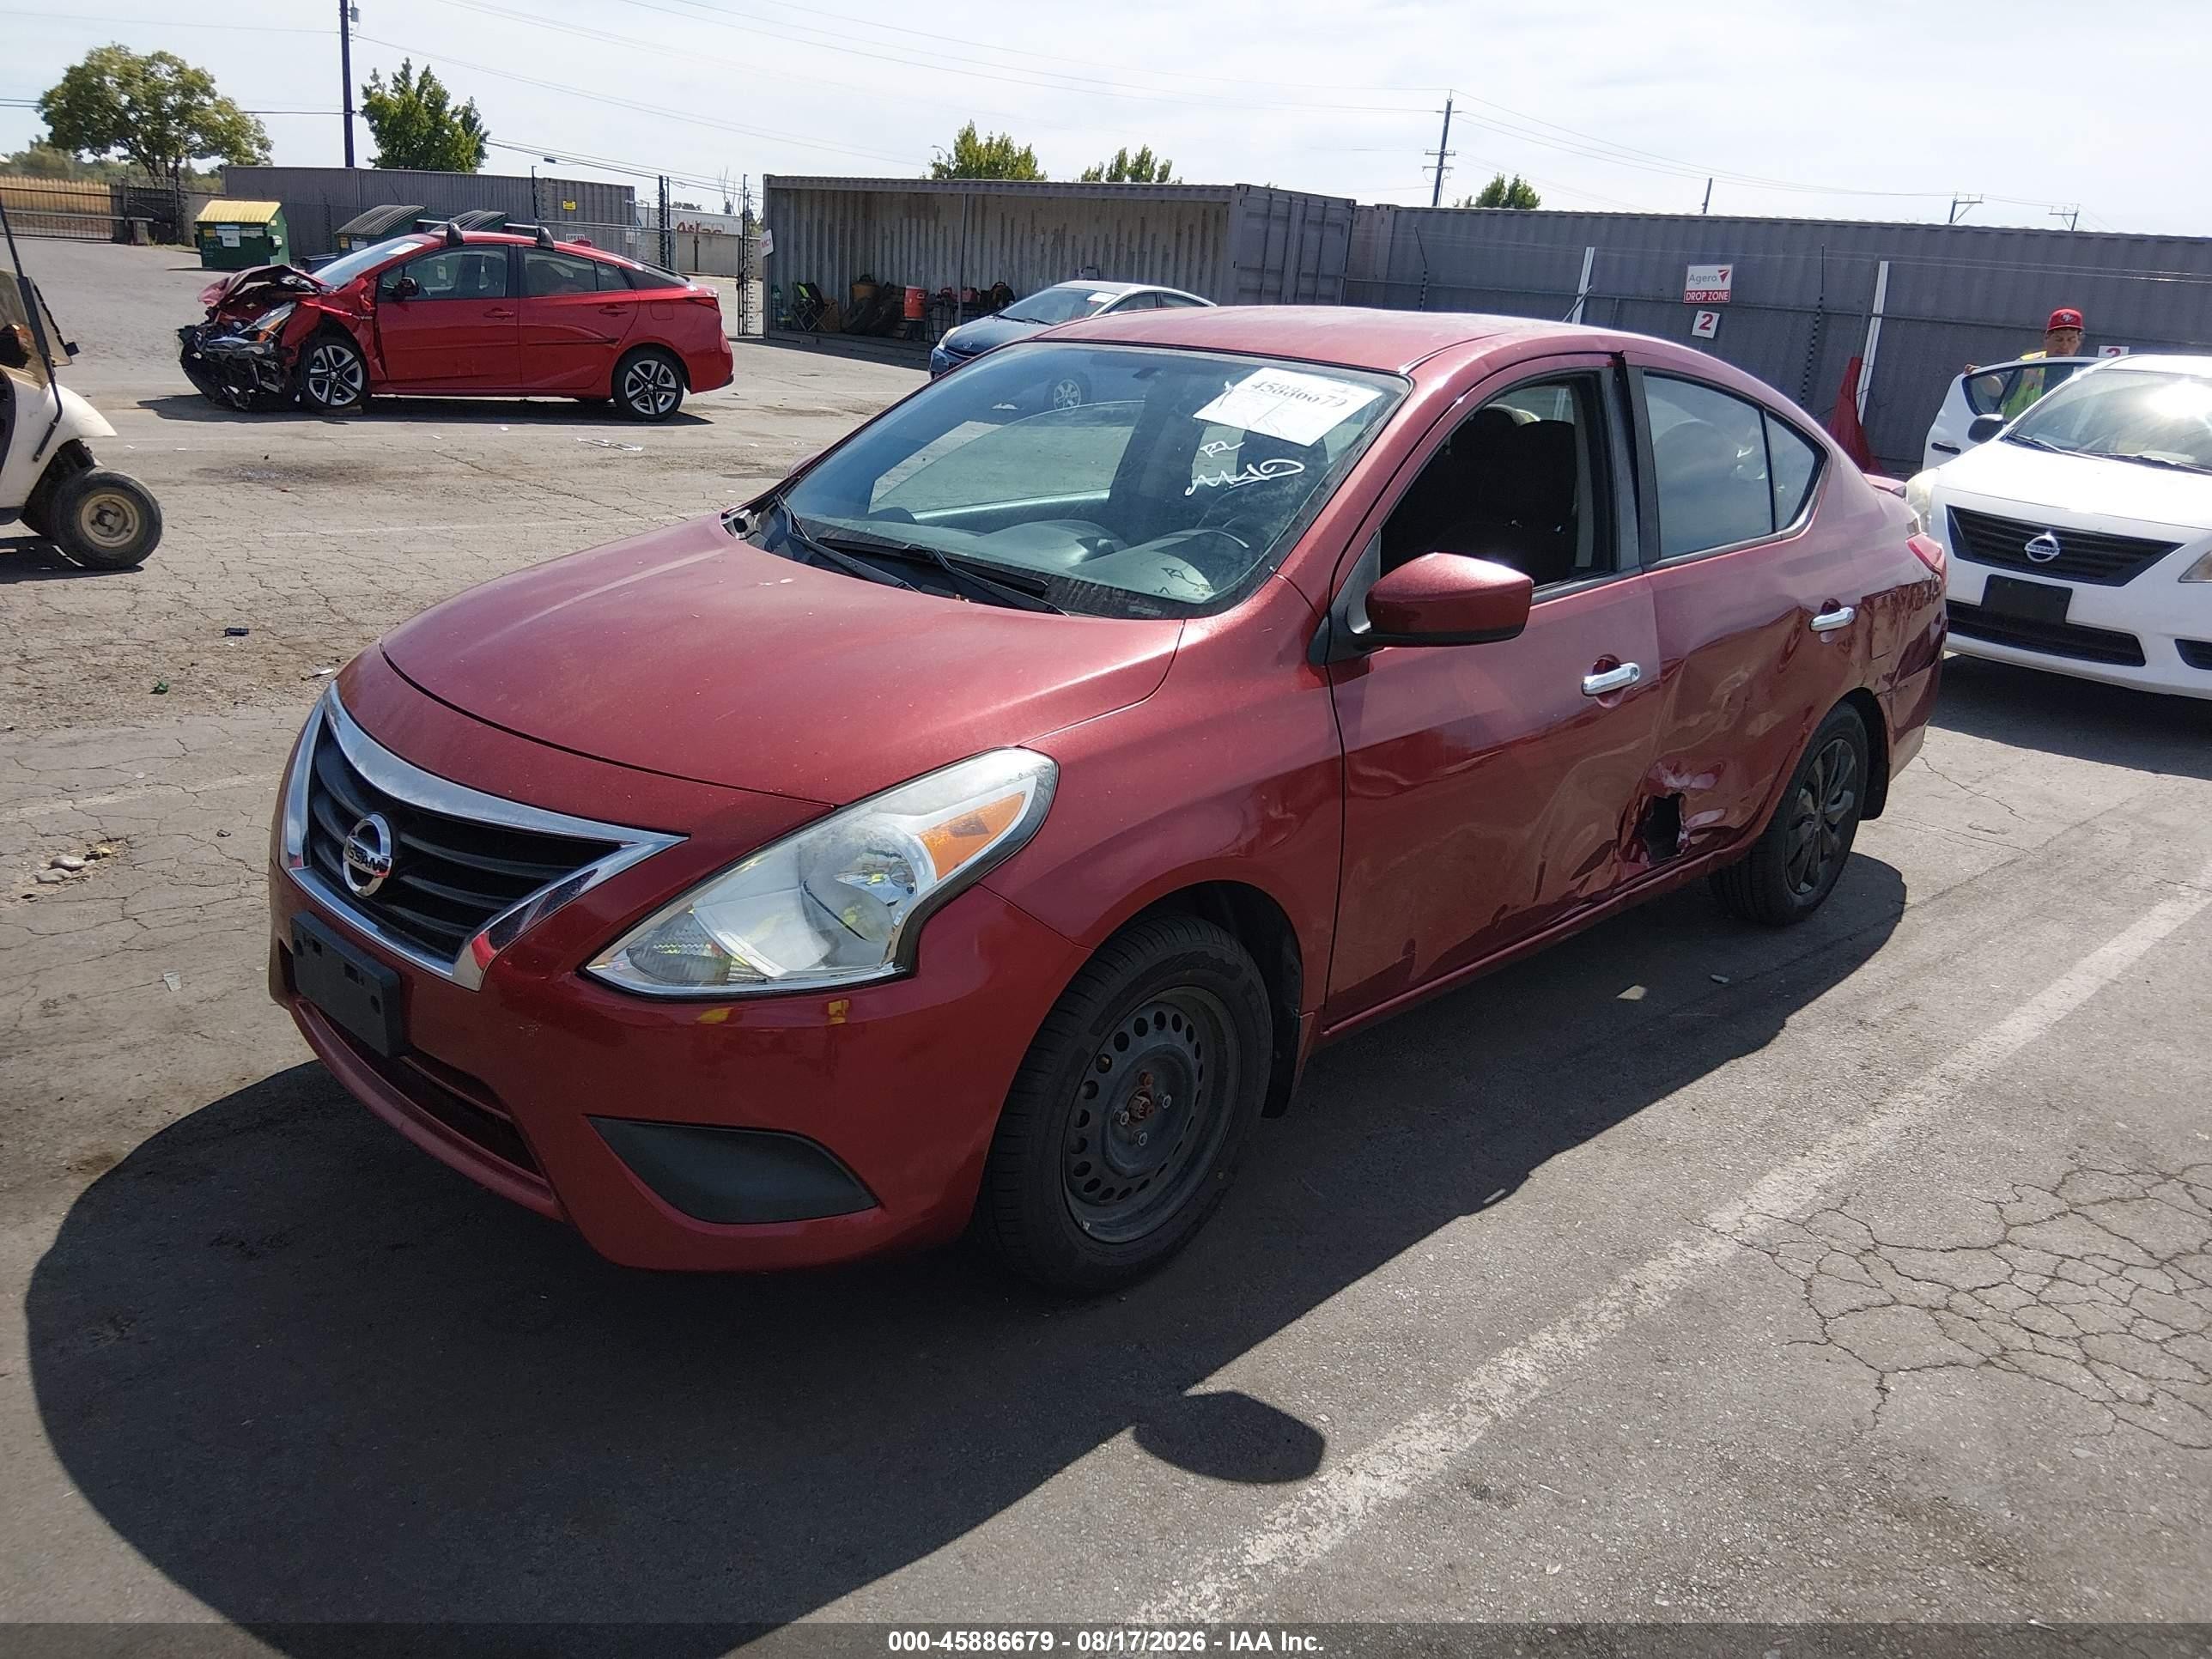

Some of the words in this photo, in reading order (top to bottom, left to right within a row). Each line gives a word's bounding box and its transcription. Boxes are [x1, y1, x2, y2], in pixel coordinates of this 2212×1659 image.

[1688, 274, 1717, 284] Agero
[1686, 291, 1706, 301] DROP
[1708, 291, 1729, 301] ZONE
[1698, 313, 1713, 331] 2
